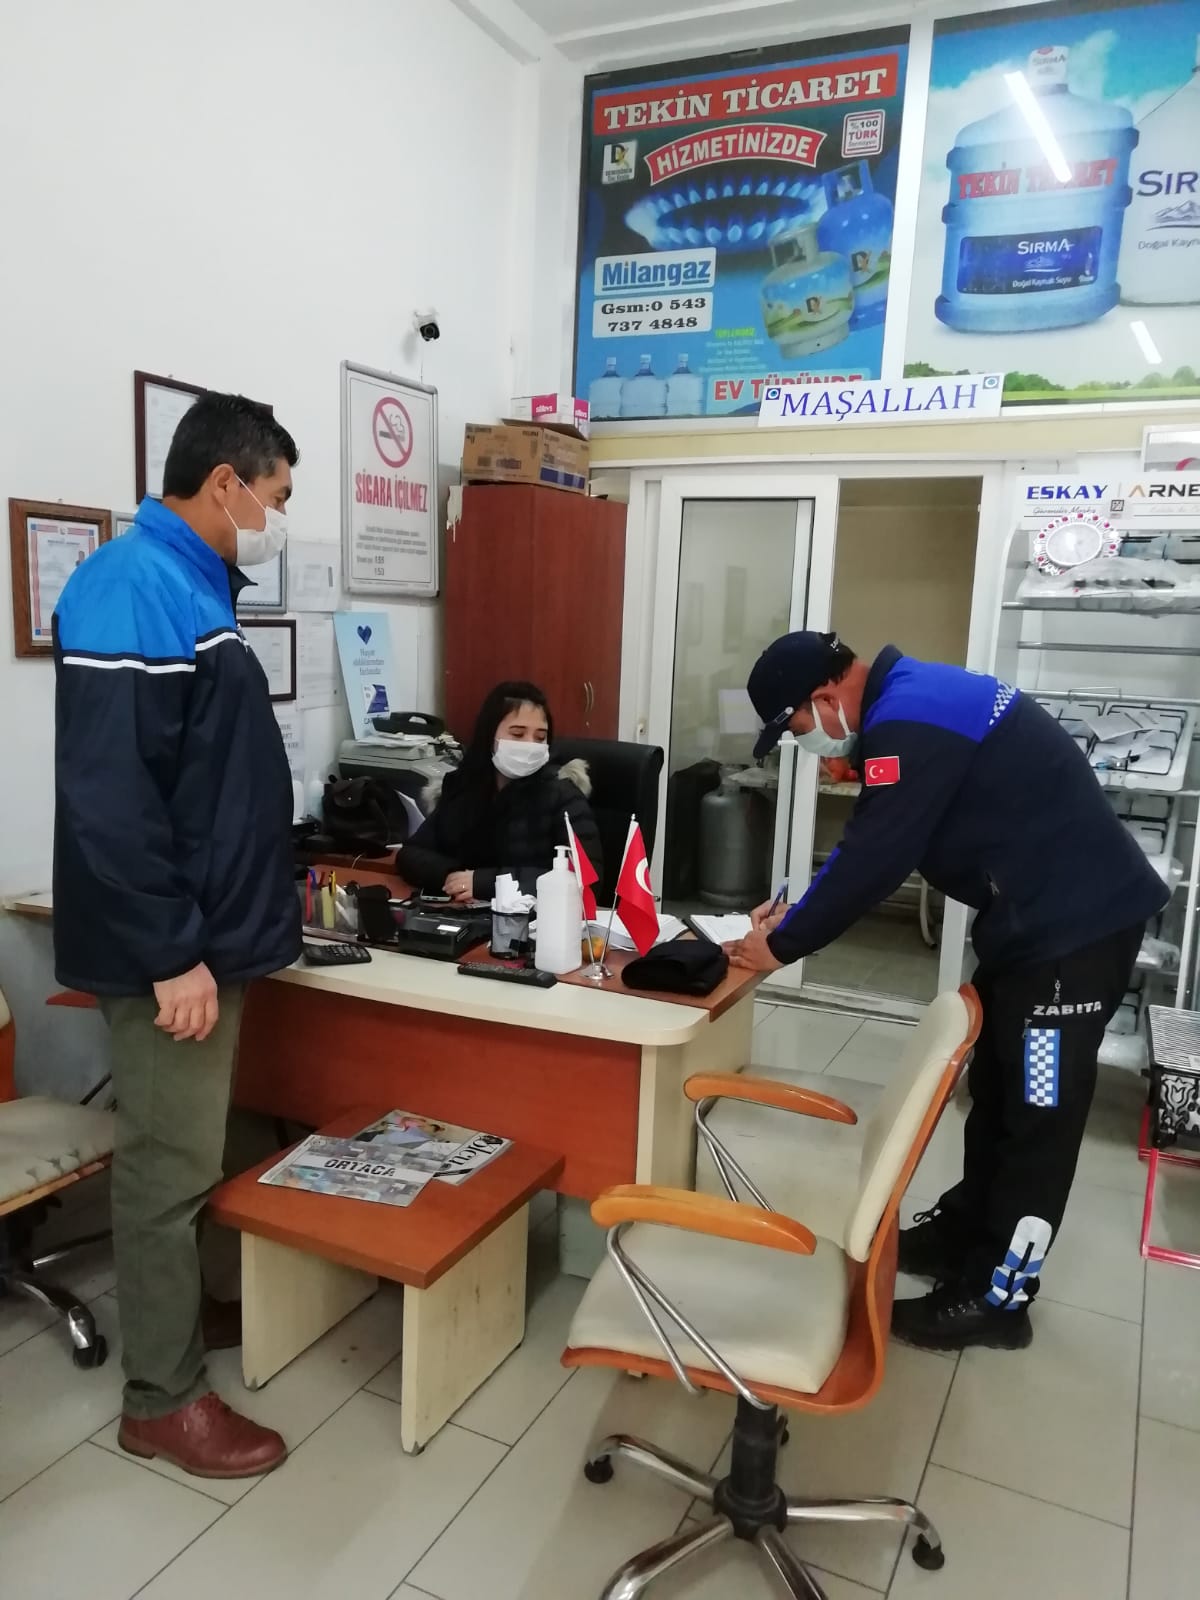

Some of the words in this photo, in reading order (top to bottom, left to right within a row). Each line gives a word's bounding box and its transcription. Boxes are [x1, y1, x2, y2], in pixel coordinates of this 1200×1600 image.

[604, 89, 712, 130] TEKİN
[723, 67, 888, 115] TİCARET
[656, 126, 813, 176] HİZMETİNİZDE
[1017, 238, 1075, 256] SIRMA
[602, 260, 712, 286] Milangaz
[669, 297, 706, 311] 543
[607, 320, 643, 332] 737
[649, 317, 698, 330] 4848
[714, 379, 745, 401] EV
[780, 383, 978, 421] MAŞALLAH
[355, 468, 393, 508] SİGARA
[395, 474, 428, 514] İÇİLMEZ
[1026, 484, 1108, 500] ESKAY
[1033, 1001, 1102, 1016] ZABITA
[324, 1158, 397, 1177] ORTACA
